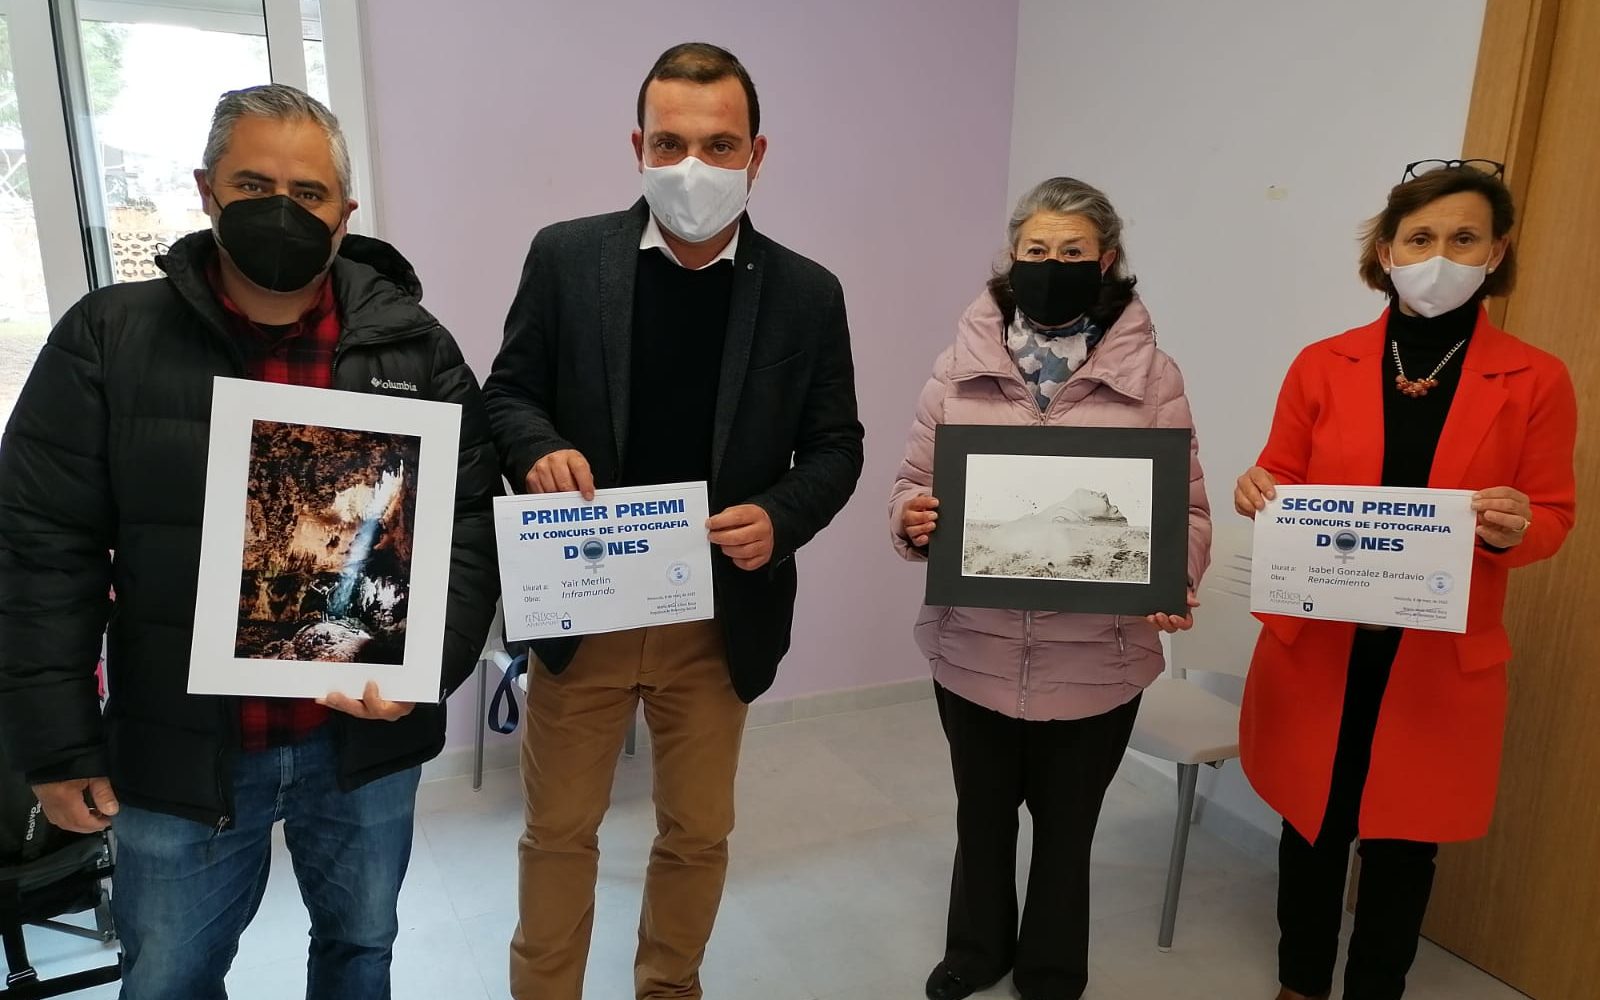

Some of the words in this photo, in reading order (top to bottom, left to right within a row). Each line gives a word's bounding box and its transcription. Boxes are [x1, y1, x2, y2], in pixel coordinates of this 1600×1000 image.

[380, 379, 418, 391] olumbia
[522, 506, 608, 525] PRIMER
[615, 499, 685, 518] PREMI
[1282, 498, 1354, 513] SEGON
[1362, 501, 1436, 517] PREMI
[519, 532, 540, 541] XVI
[543, 528, 596, 539] CONCURS
[599, 526, 614, 535] DE
[617, 520, 689, 533] FOTOGRAFIA
[1275, 517, 1296, 525] XVI
[1299, 518, 1351, 528] CONCURS
[1354, 521, 1370, 529] DE
[1373, 522, 1452, 533] FOTOGRAFIA
[1308, 565, 1335, 574] Isabel
[1382, 570, 1425, 581] Bardavio
[1307, 575, 1370, 588] Renacimiento
[561, 586, 615, 599] Inframundo
